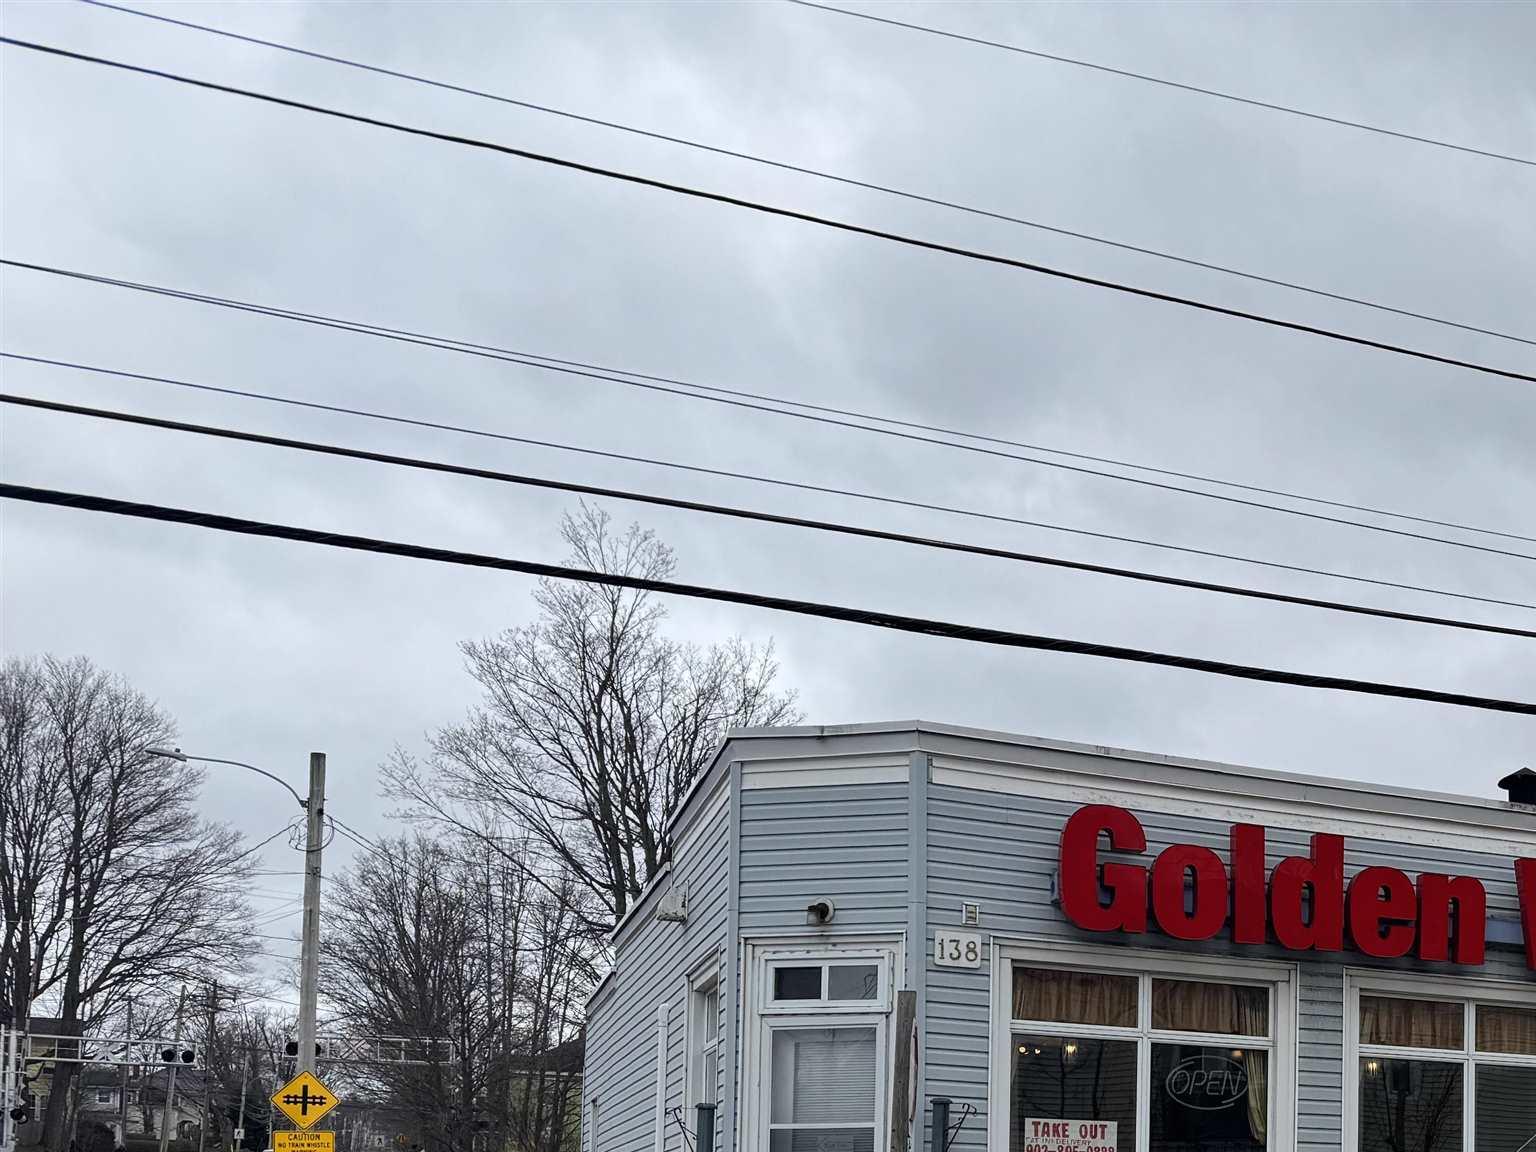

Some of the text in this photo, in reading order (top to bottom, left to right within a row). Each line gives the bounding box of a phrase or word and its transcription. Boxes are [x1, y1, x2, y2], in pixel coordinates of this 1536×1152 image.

[1059, 803, 1487, 965] Golden
[938, 938, 978, 962] 138
[1170, 1069, 1243, 1096] OPEN
[1031, 1121, 1108, 1140] TAKE OUT
